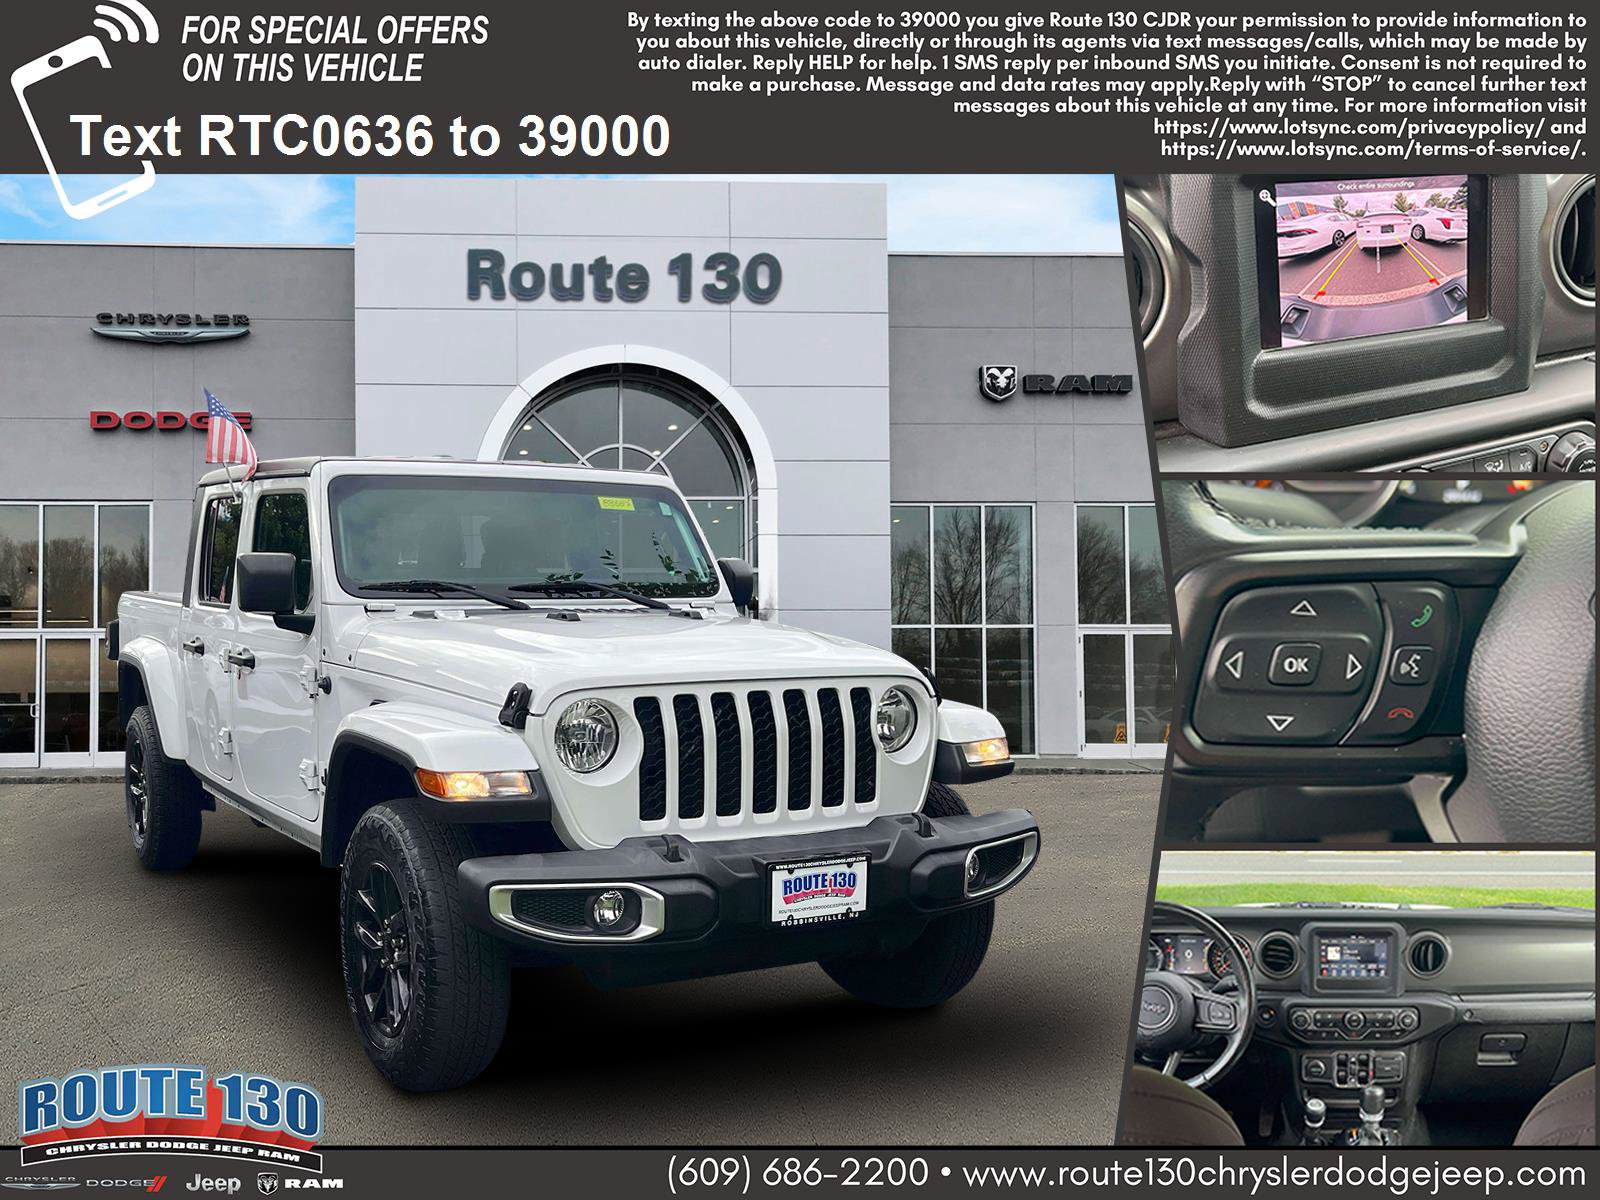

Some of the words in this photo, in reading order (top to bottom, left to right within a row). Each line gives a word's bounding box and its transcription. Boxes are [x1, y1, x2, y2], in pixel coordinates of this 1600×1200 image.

[467, 249, 649, 301] Route
[668, 252, 782, 304] 130
[96, 312, 249, 325] CHRYSLER
[1023, 375, 1133, 393] RAM
[1284, 658, 1308, 672] OK
[783, 873, 828, 896] ROUTE
[831, 872, 856, 888] 130
[781, 913, 845, 926] ROBBINSVILLE,
